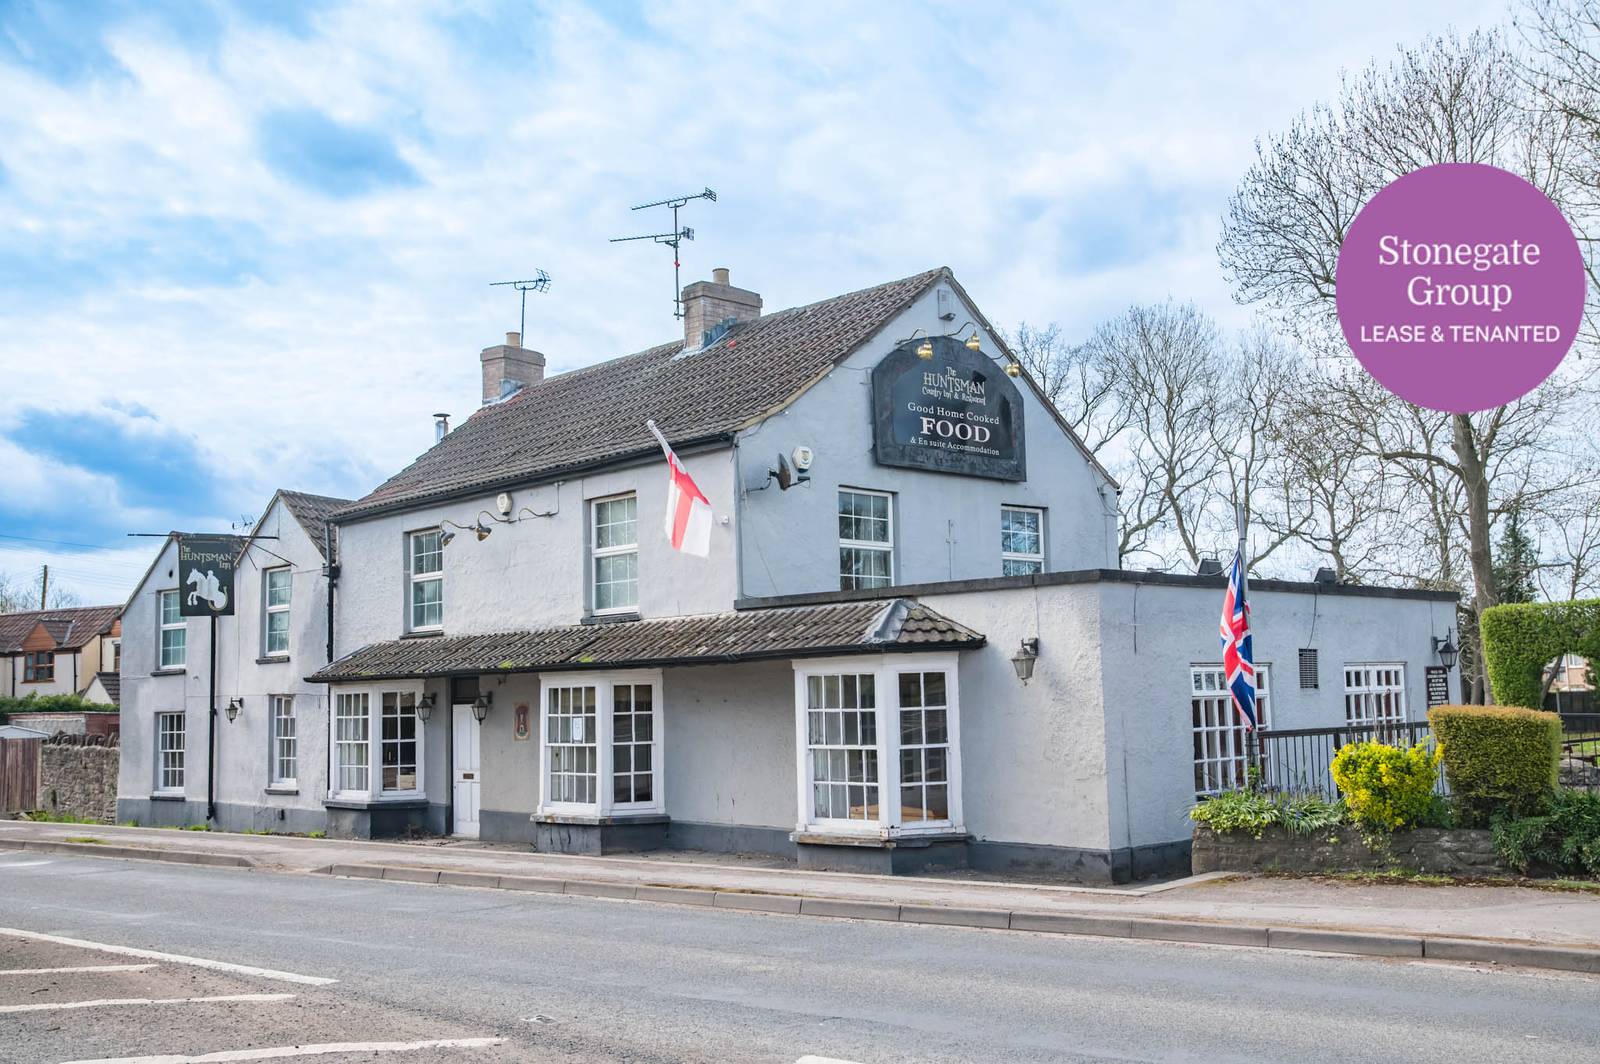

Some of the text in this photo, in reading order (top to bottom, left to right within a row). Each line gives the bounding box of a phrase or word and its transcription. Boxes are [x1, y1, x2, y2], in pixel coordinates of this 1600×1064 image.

[946, 366, 956, 376] The
[923, 372, 985, 395] HUNTSMAN
[953, 391, 960, 400] &
[907, 401, 1000, 425] Good Home Cooked
[920, 416, 991, 443] FOOD
[910, 436, 1000, 456] & En suite Accommodation
[180, 552, 231, 563] HUNTSMAN
